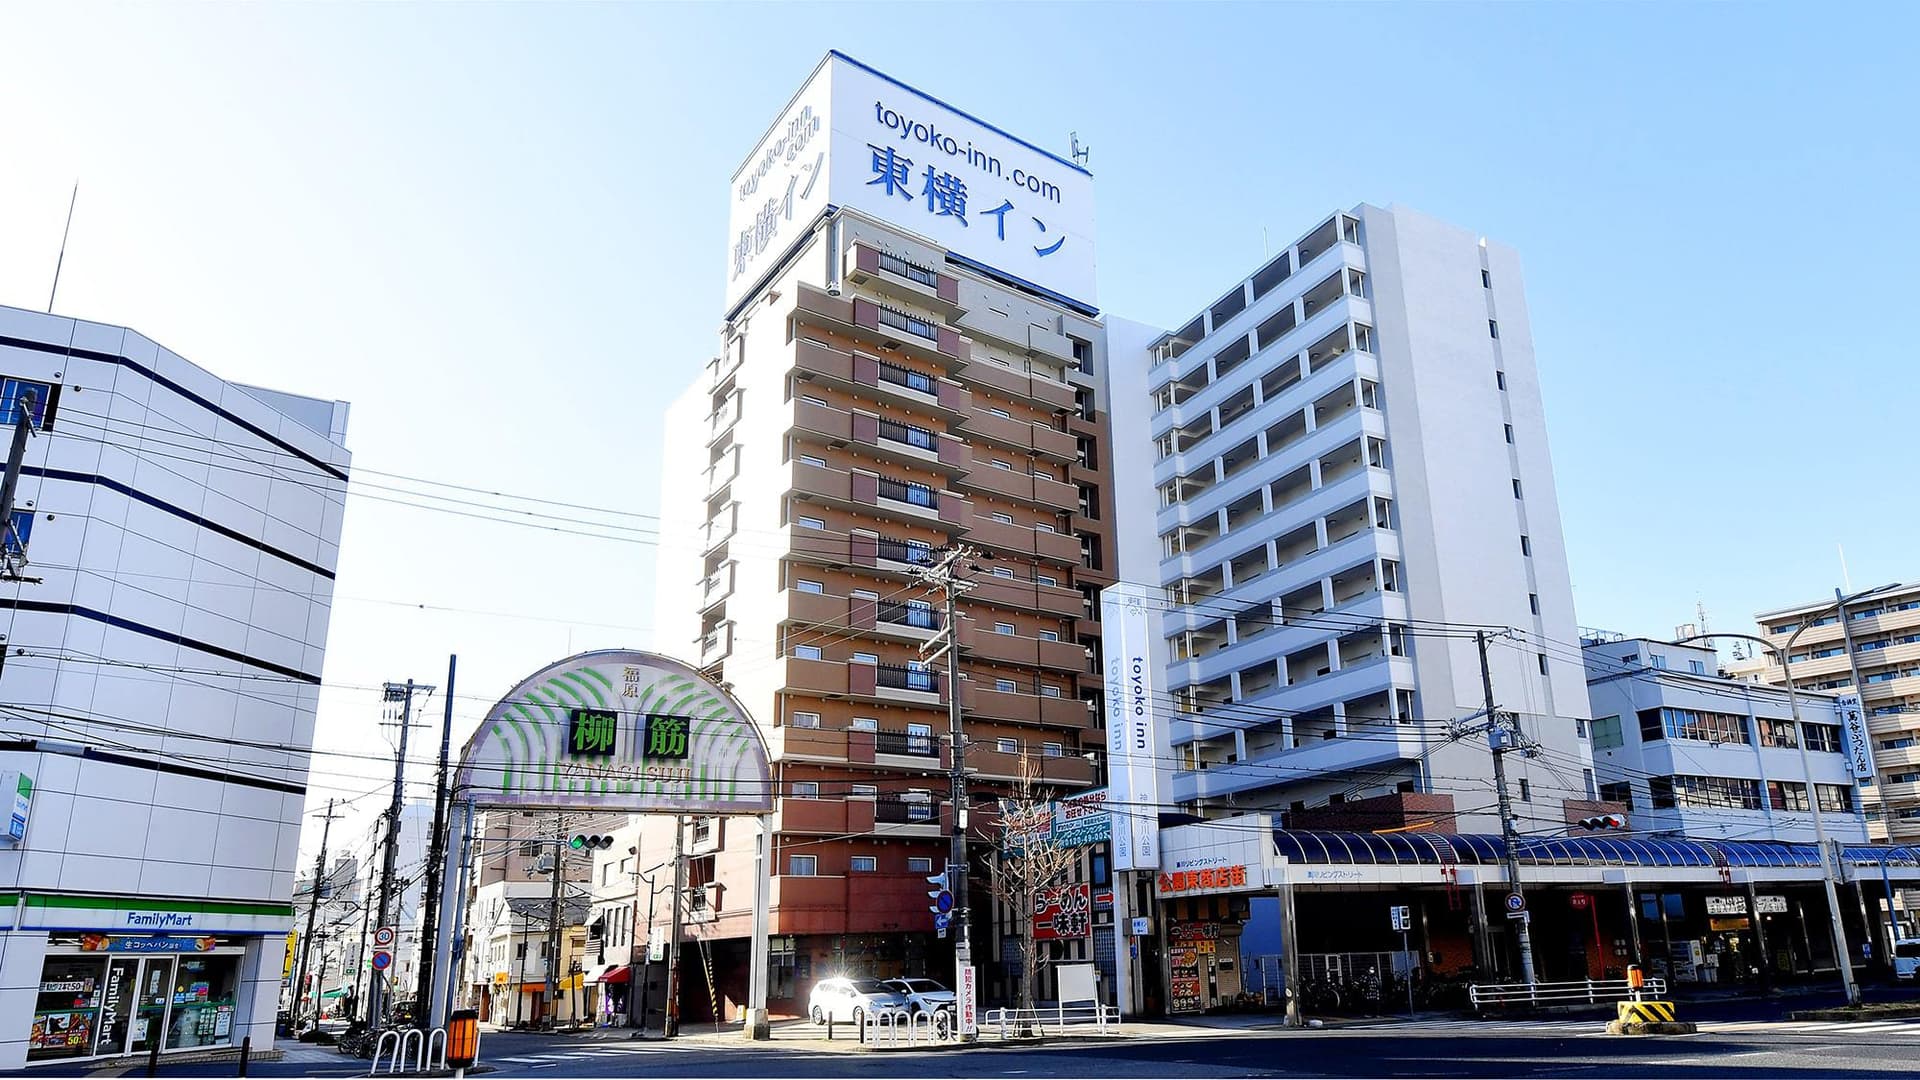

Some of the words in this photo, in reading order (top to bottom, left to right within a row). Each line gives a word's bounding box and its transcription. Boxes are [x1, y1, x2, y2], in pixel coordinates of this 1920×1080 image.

[873, 99, 1062, 204] toyoko-inn.com
[866, 142, 1066, 257] 東横イン
[622, 665, 640, 699] 福原
[1110, 658, 1121, 719] toyoko
[1130, 656, 1144, 716] toyoko
[1113, 722, 1122, 751] inn
[1135, 720, 1146, 750] inn
[1117, 795, 1127, 858] 湊川公園
[1139, 793, 1151, 857] 神戸川公園
[1158, 864, 1247, 893] 公園東商店街
[1035, 887, 1088, 914] らーめん
[126, 911, 193, 929] FamilyMart
[379, 931, 390, 940] 30
[1036, 910, 1089, 936] 一味軒
[101, 967, 124, 1046] FamilyMart
